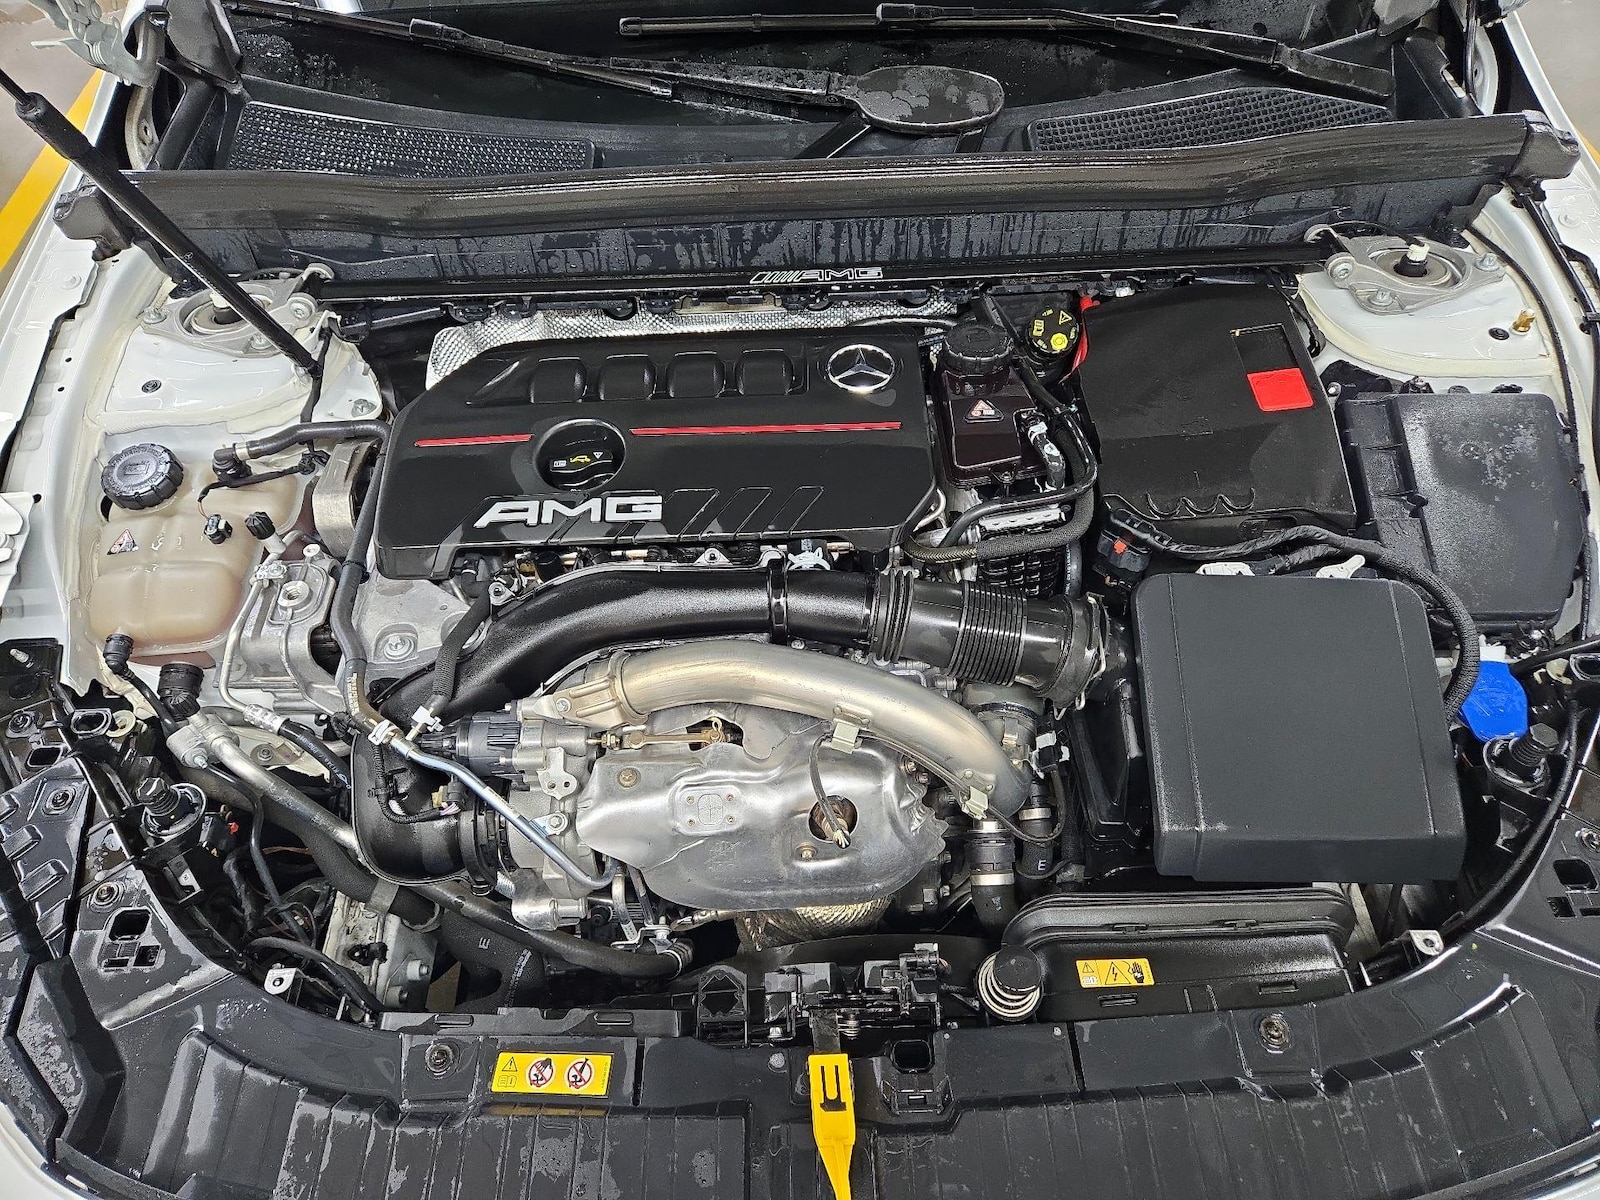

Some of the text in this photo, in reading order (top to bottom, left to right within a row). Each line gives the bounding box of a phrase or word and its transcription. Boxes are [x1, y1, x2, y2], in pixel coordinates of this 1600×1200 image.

[793, 267, 883, 281] AMG
[473, 495, 663, 528] AMG
[1038, 859, 1047, 871] E
[478, 937, 491, 949] E
